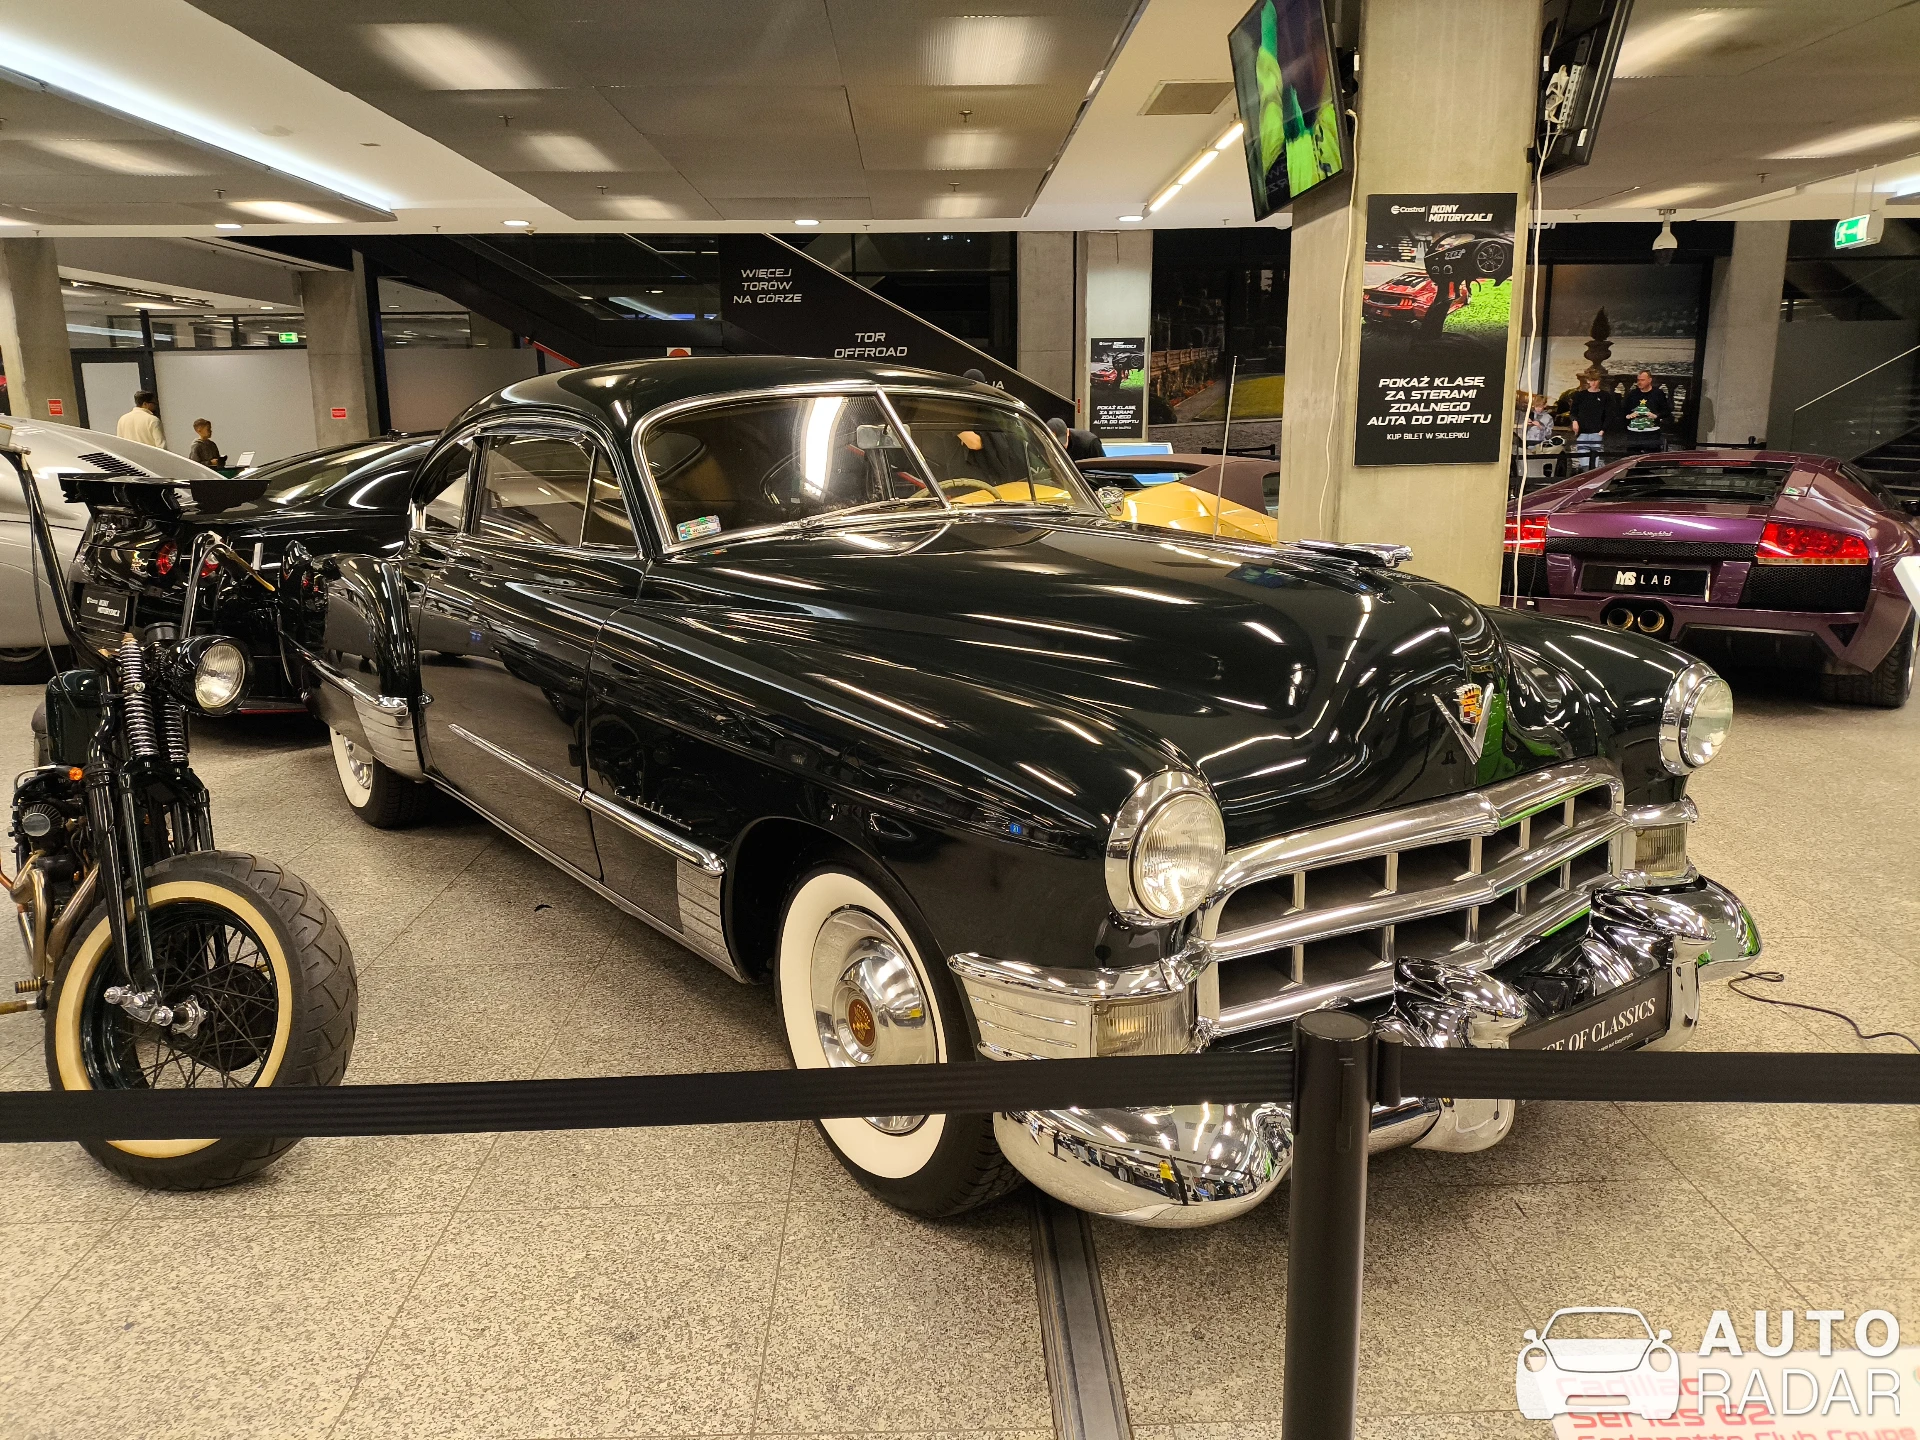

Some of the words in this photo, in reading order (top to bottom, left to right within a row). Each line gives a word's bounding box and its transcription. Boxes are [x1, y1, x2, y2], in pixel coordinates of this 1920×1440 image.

[1429, 204, 1460, 214] IKONY
[1428, 213, 1494, 223] MOTORYZACJI
[740, 268, 792, 279] WIĘCEJ
[741, 280, 793, 291] TORÓW
[733, 295, 752, 304] NA
[756, 293, 803, 304] GÓRZE
[854, 332, 886, 343] TOR
[834, 346, 908, 359] OFFROAD
[1378, 375, 1431, 388] POKAŻ
[1433, 376, 1486, 388] KLASĘ
[1384, 390, 1406, 401] ZA
[1410, 389, 1478, 400] STERAMI
[1388, 401, 1471, 413] ZDALNEGO
[1366, 415, 1407, 426] AUTA
[1410, 415, 1433, 425] DO
[1436, 414, 1492, 425] DRIFTU
[1386, 433, 1402, 441] KUP
[1403, 432, 1424, 440] BILET
[1425, 432, 1434, 440] W
[1435, 431, 1470, 440] SKLEPIKU
[1640, 574, 1671, 586] LAB
[1568, 1028, 1590, 1051] OF
[1591, 997, 1657, 1043] CLASSICS
[1567, 1404, 1706, 1429] Series
[1715, 1403, 1776, 1427] 62
